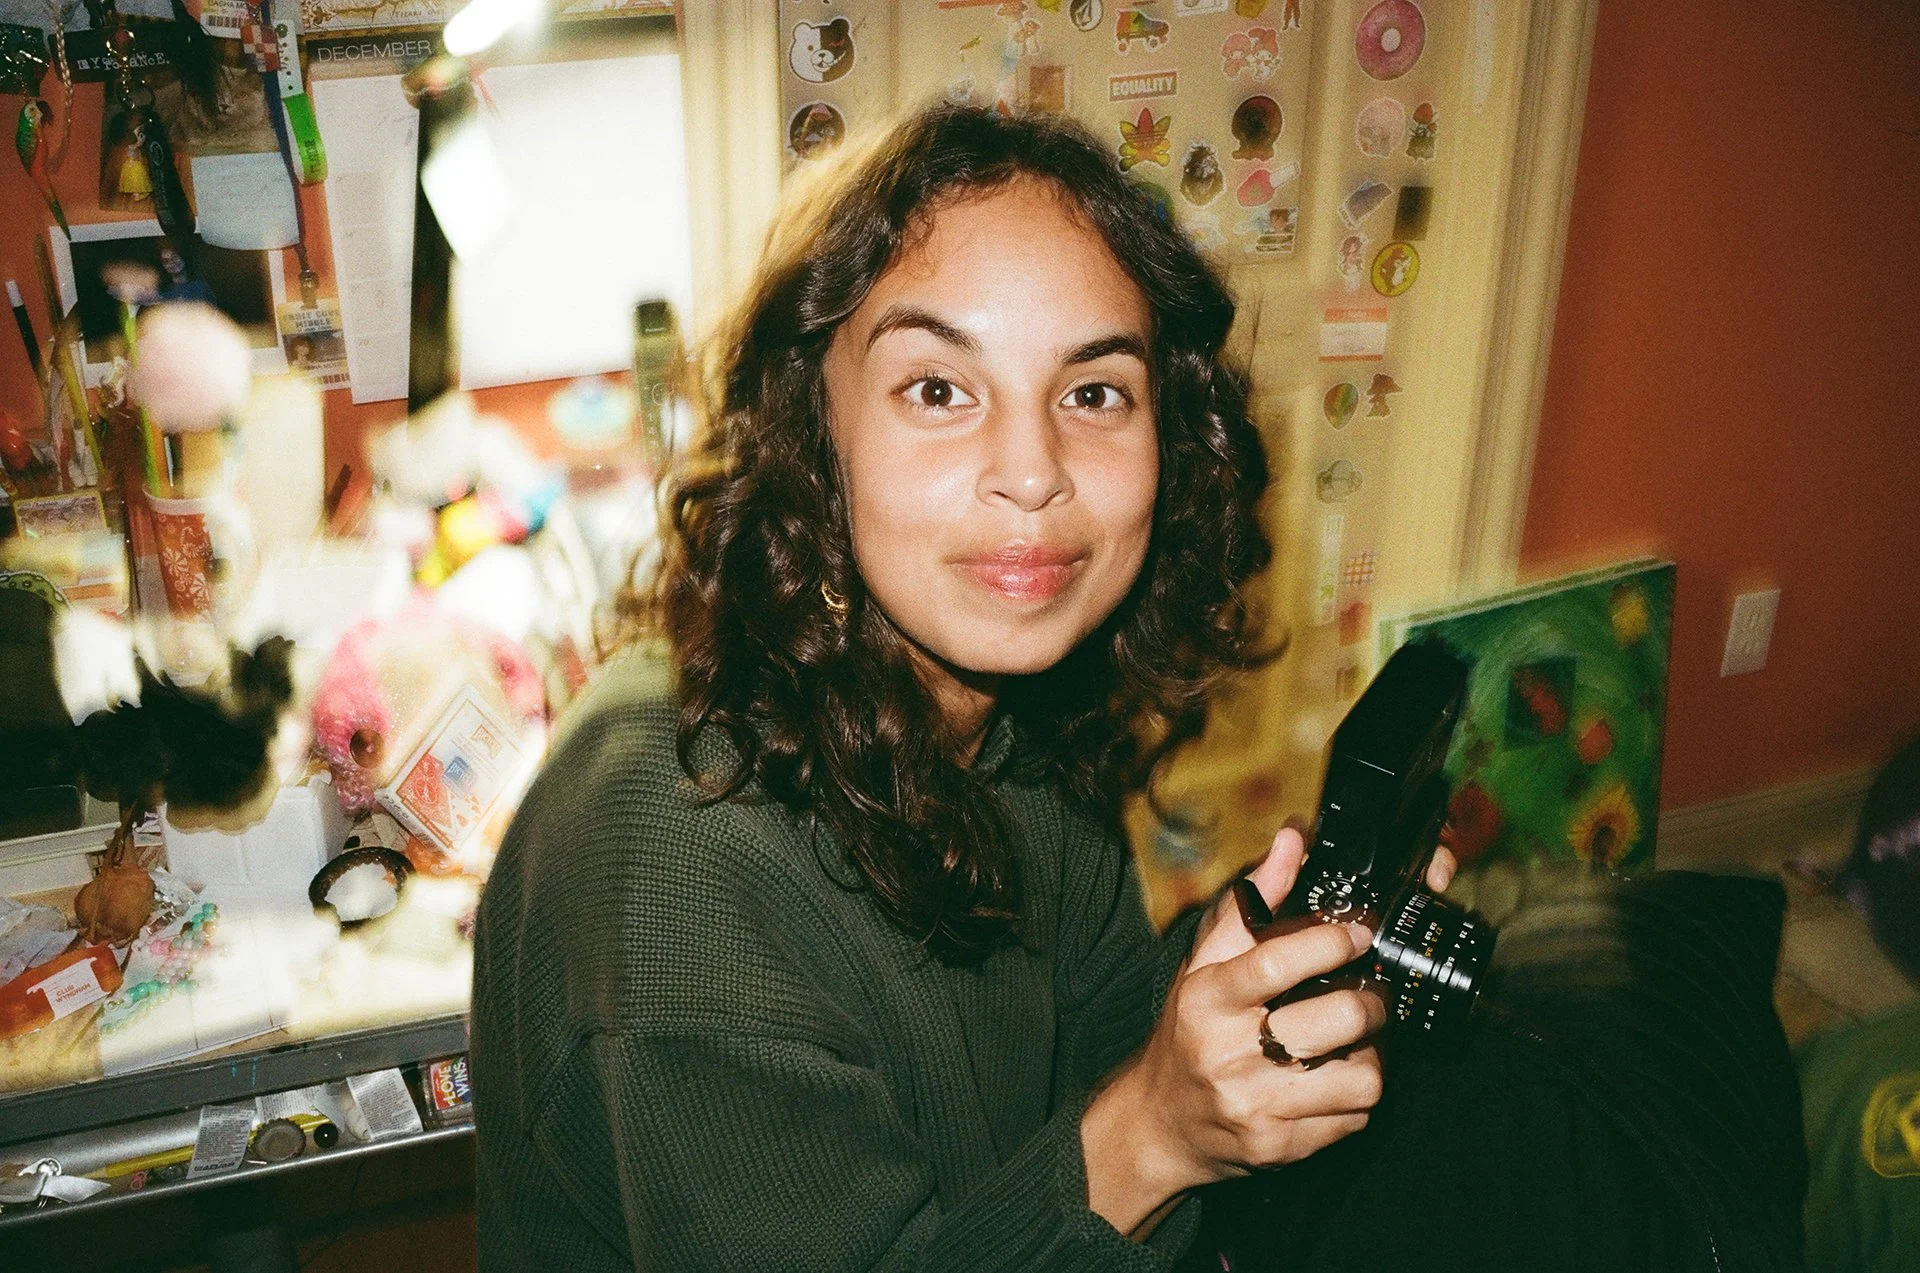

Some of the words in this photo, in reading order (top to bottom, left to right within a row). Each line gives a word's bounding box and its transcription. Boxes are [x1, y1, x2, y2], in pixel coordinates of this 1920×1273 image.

[317, 40, 433, 62] DECEMBER
[1113, 76, 1173, 96] EQUALITY
[1330, 803, 1341, 811] ON
[1322, 840, 1335, 848] OFF
[56, 984, 75, 996] CLUB
[56, 983, 91, 1002] WYNDHAM
[440, 1065, 457, 1101] LOVE
[453, 1062, 470, 1097] WINS
